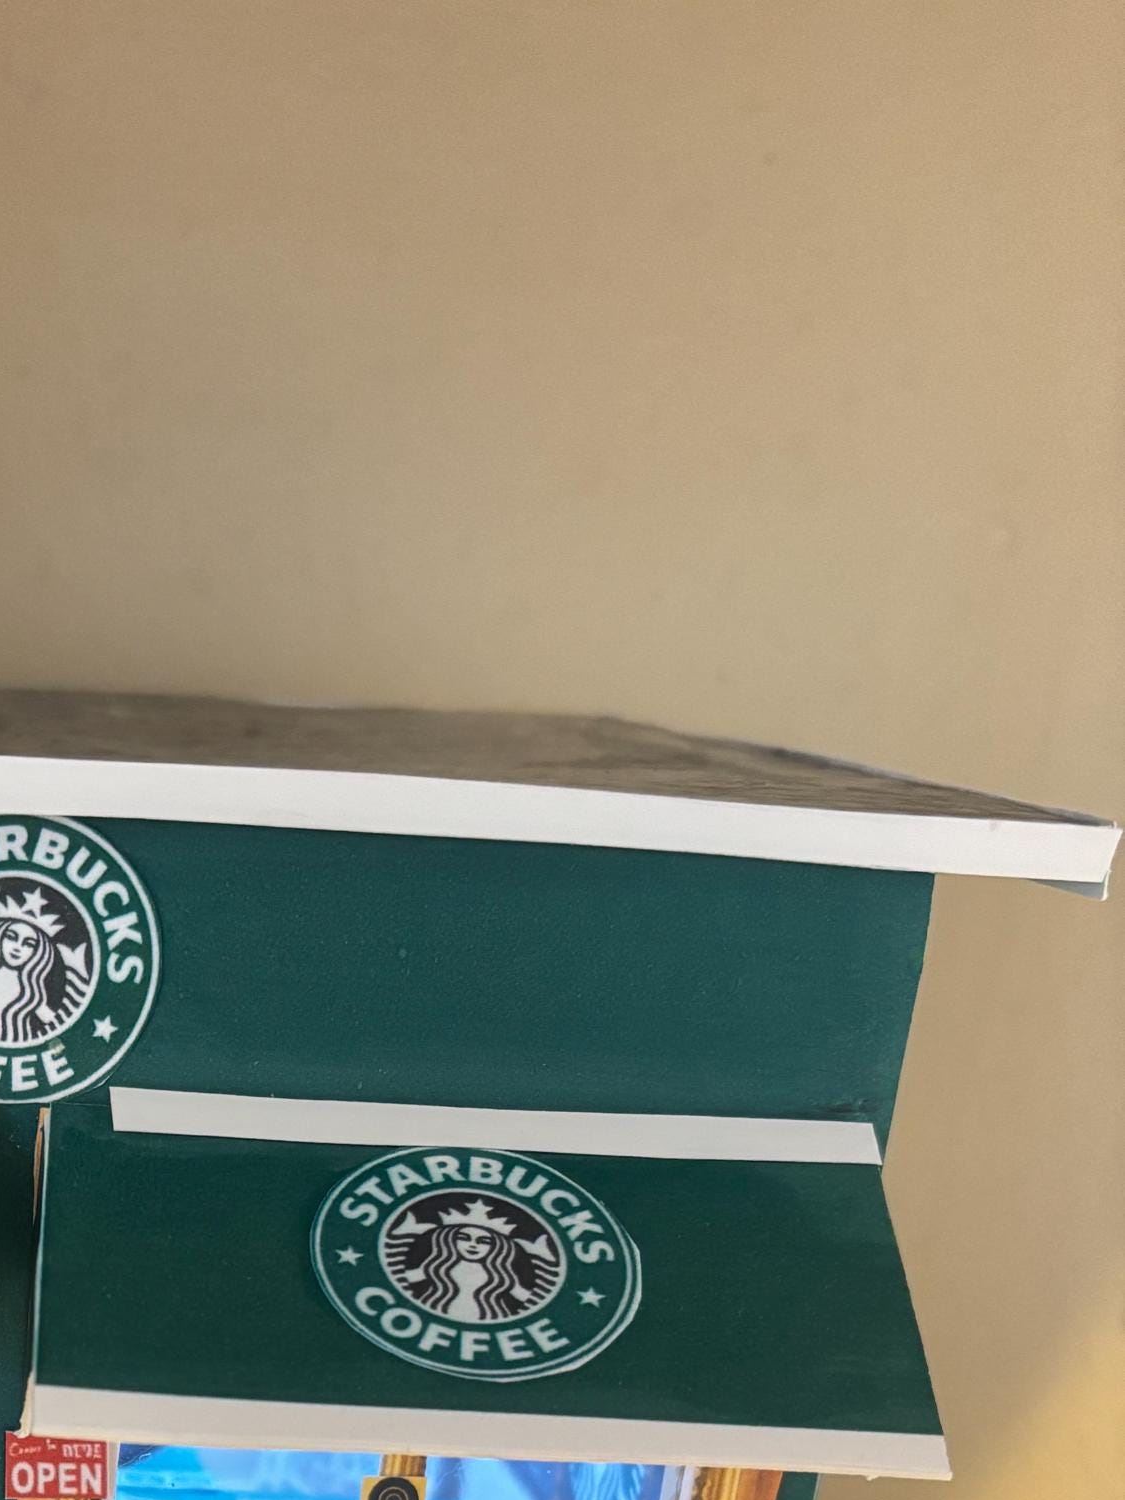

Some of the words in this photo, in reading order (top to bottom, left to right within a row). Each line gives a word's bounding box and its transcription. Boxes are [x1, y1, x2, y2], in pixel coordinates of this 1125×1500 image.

[339, 1154, 615, 1264] STARBUCKS
[354, 1286, 570, 1362] COFFEE
[11, 1461, 102, 1495] OPEN
